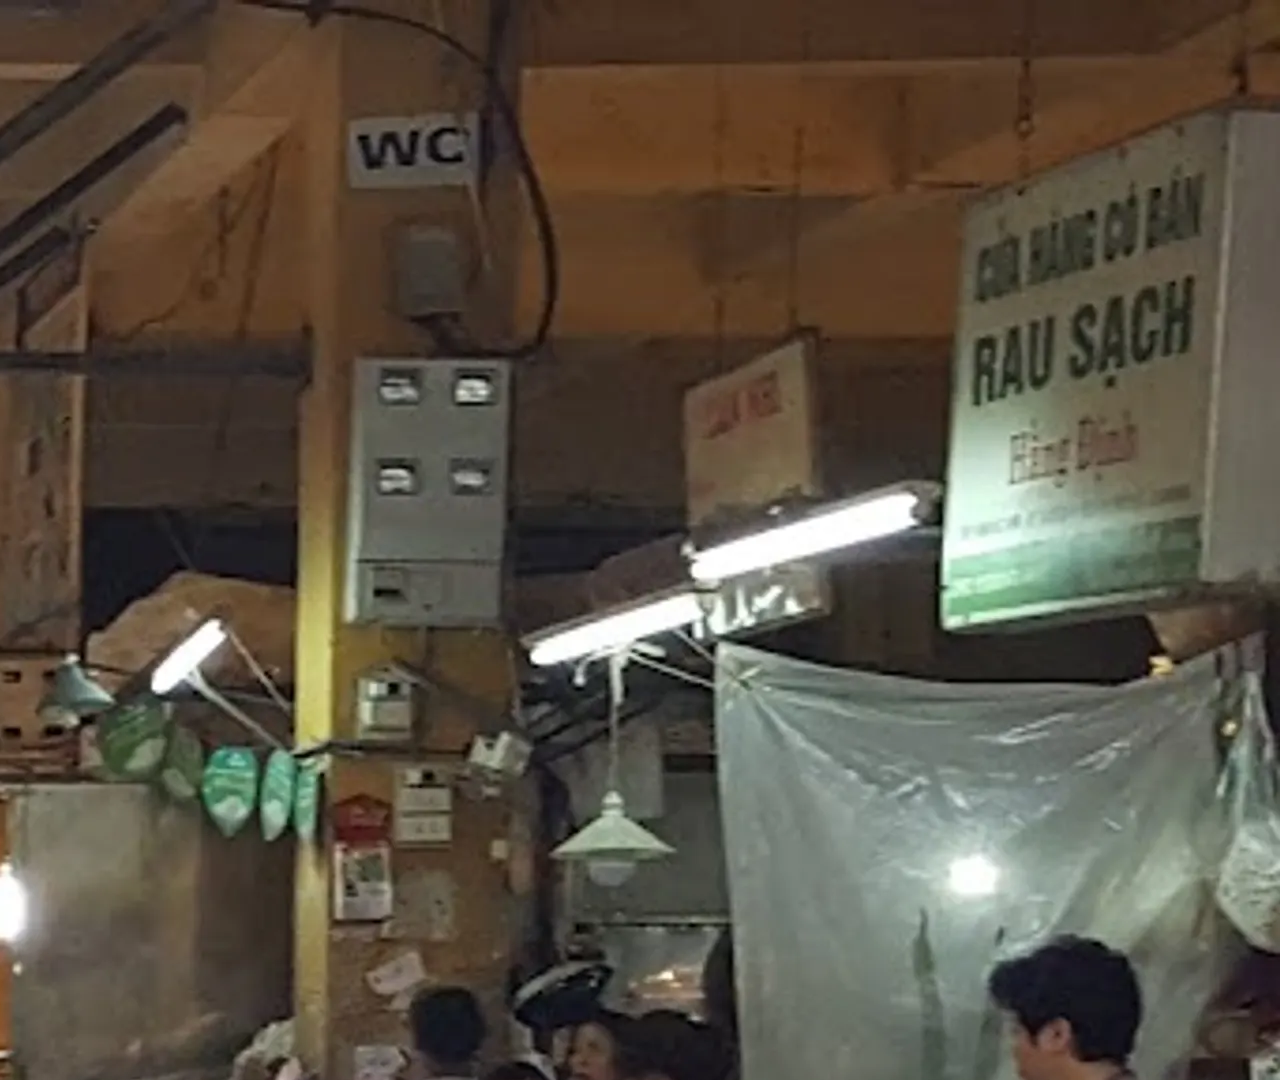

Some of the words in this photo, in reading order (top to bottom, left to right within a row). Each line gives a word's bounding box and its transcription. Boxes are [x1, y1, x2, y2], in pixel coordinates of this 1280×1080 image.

[356, 126, 468, 169] WC
[972, 316, 1056, 406] RAU
[1069, 275, 1196, 389] SẠCH
